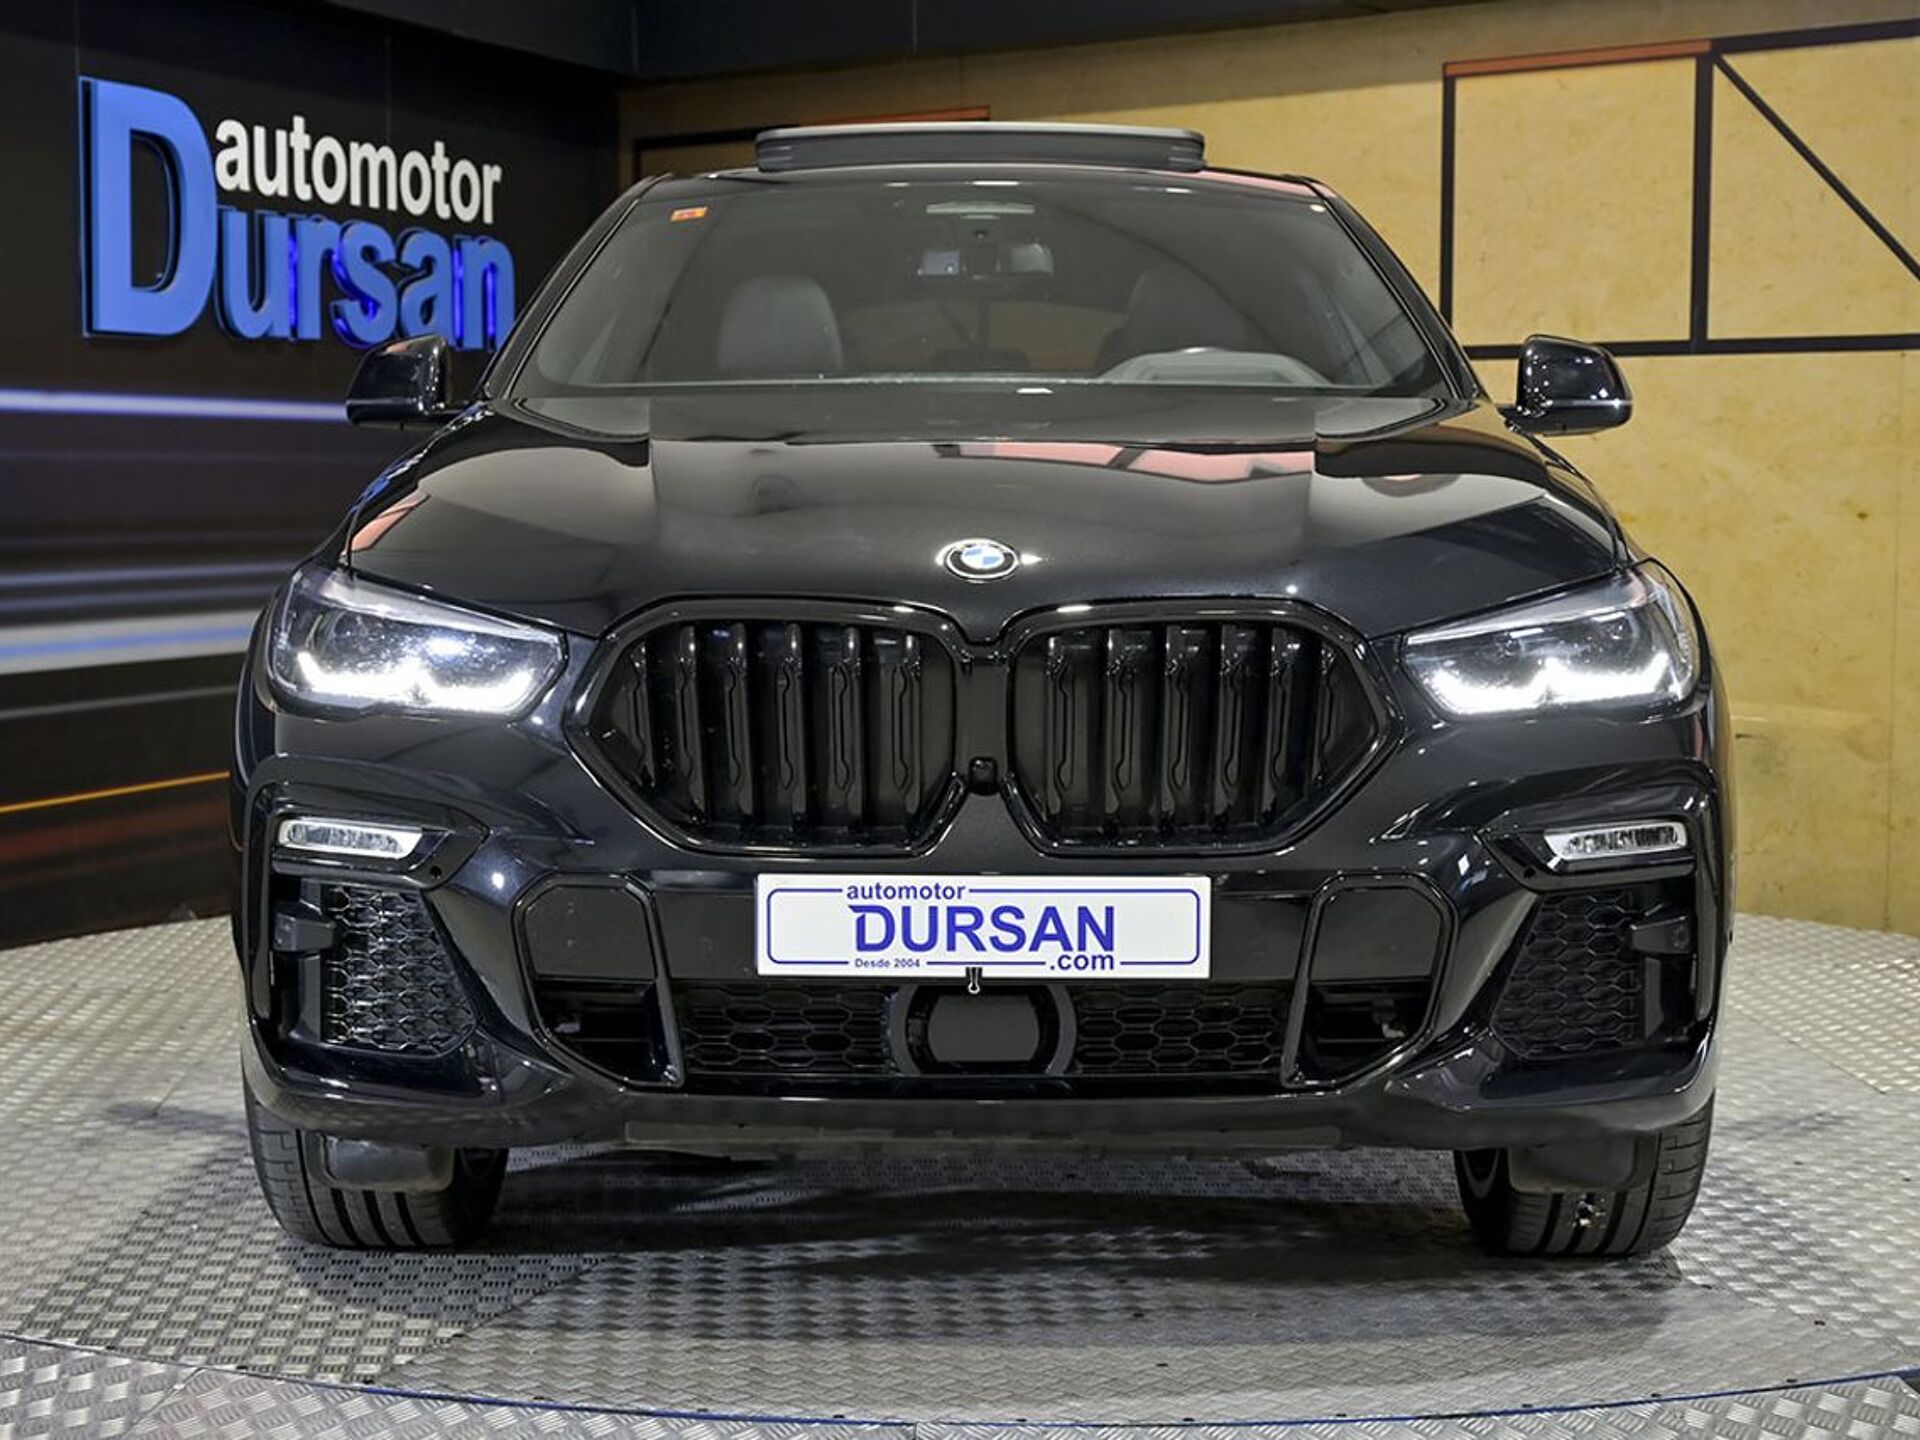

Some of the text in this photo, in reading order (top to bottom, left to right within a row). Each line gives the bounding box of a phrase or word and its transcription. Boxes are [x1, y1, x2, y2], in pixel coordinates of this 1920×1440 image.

[215, 116, 502, 224] automotor
[78, 75, 517, 352] Dursan
[847, 882, 966, 900] automotor
[848, 904, 1115, 952] DURSAN
[855, 957, 921, 968] Desde 2004
[1049, 954, 1115, 971] .com
